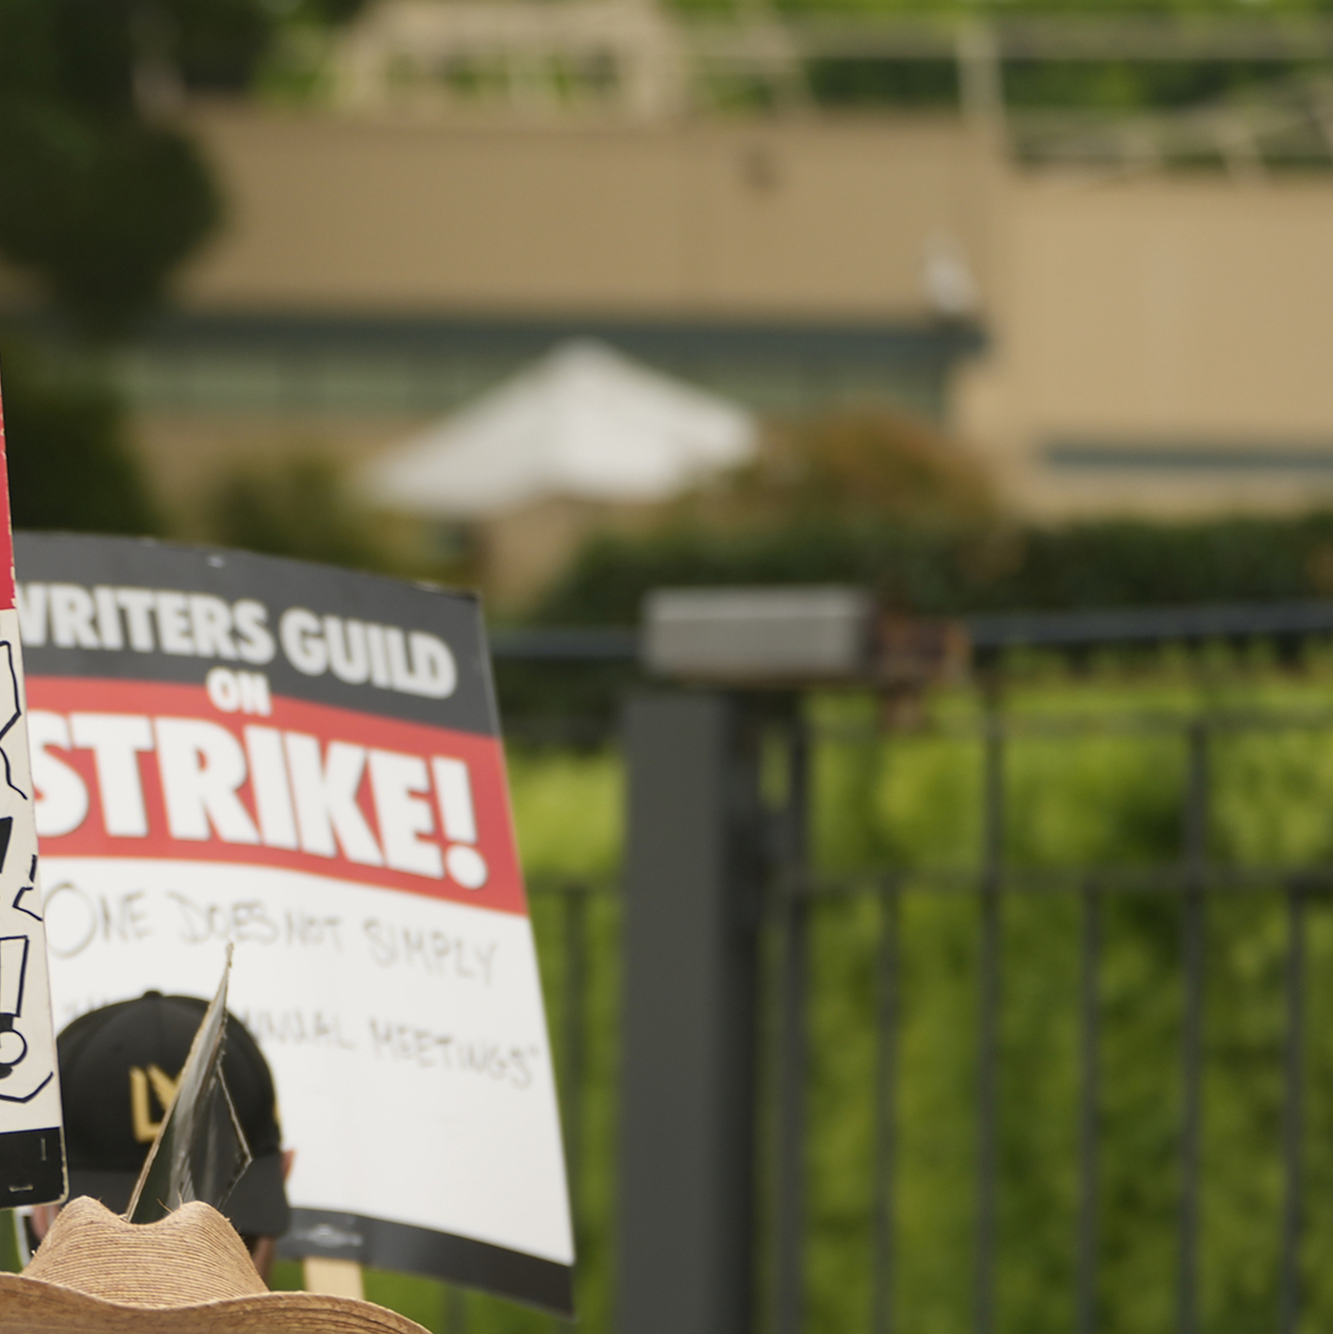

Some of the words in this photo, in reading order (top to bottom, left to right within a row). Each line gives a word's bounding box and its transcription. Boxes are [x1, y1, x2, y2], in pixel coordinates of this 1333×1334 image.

[207, 667, 272, 716] ON
[279, 606, 458, 700] GUILD
[27, 707, 489, 890] STRIKE!
[42, 881, 151, 959] ONE
[167, 891, 279, 946] DOES
[285, 904, 344, 951] NOT
[361, 916, 498, 990] SIMPLY
